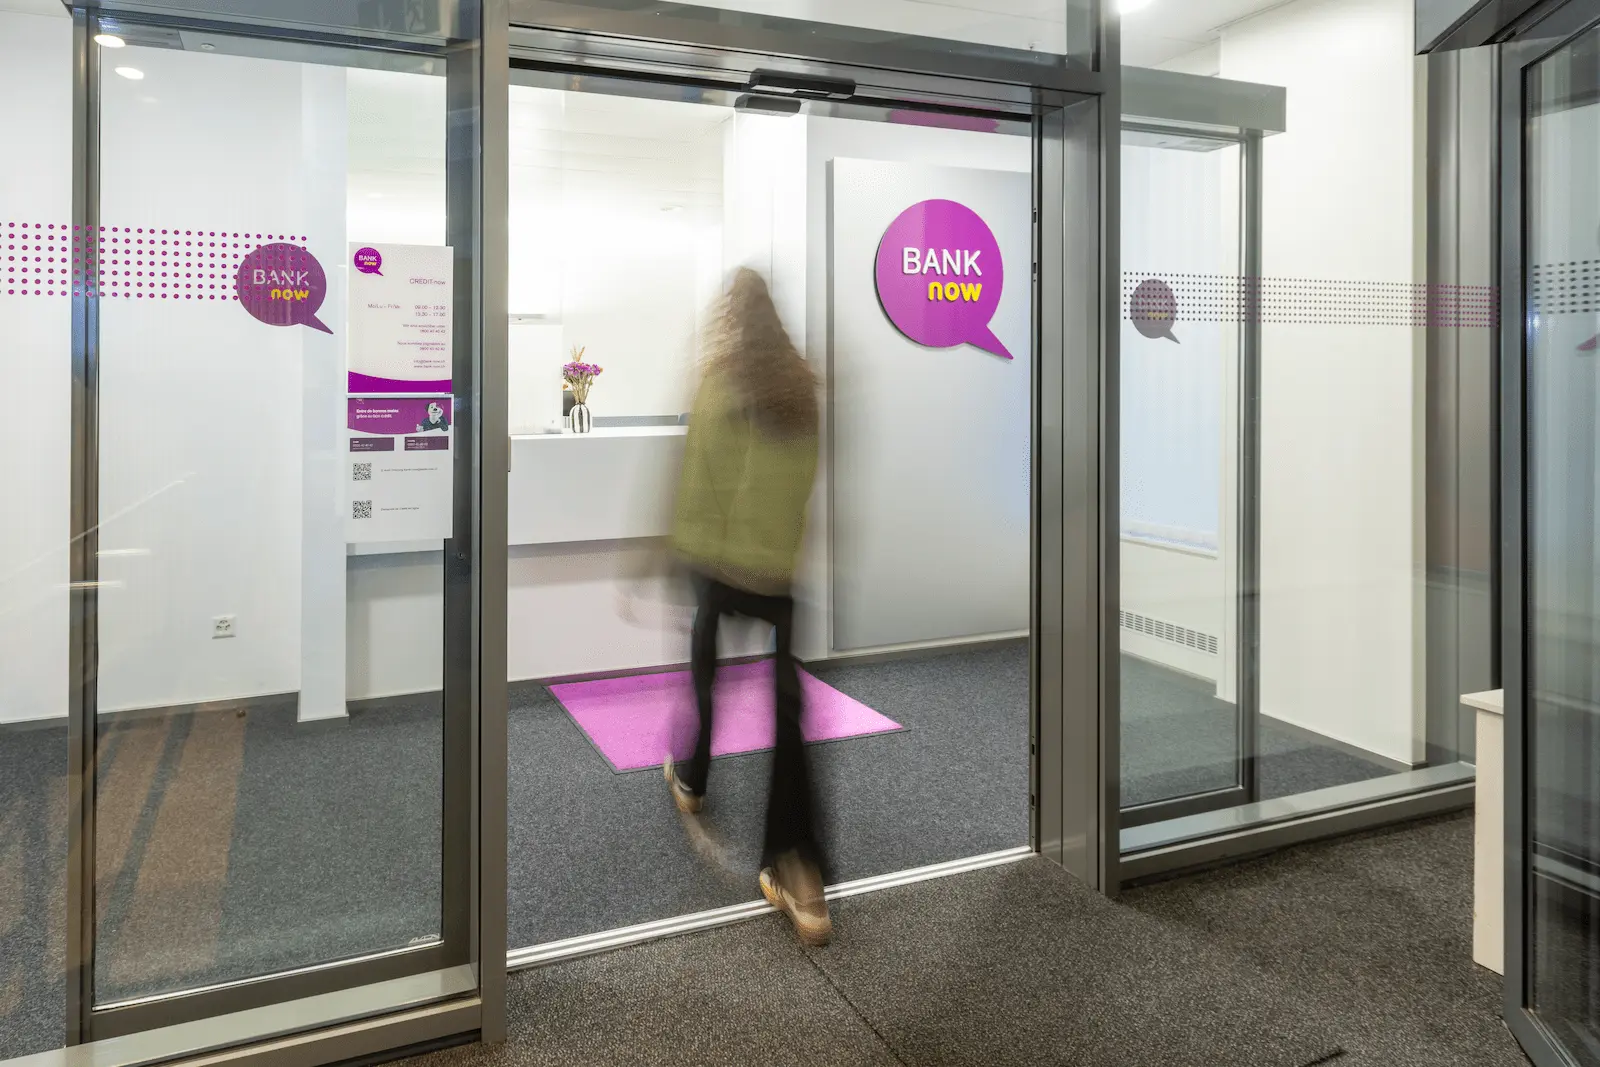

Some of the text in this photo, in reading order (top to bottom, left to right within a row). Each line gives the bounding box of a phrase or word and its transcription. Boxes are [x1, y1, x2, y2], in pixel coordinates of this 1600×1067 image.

[903, 247, 982, 276] BANK
[253, 269, 310, 286] BANK
[271, 288, 310, 301] now
[928, 281, 982, 302] now
